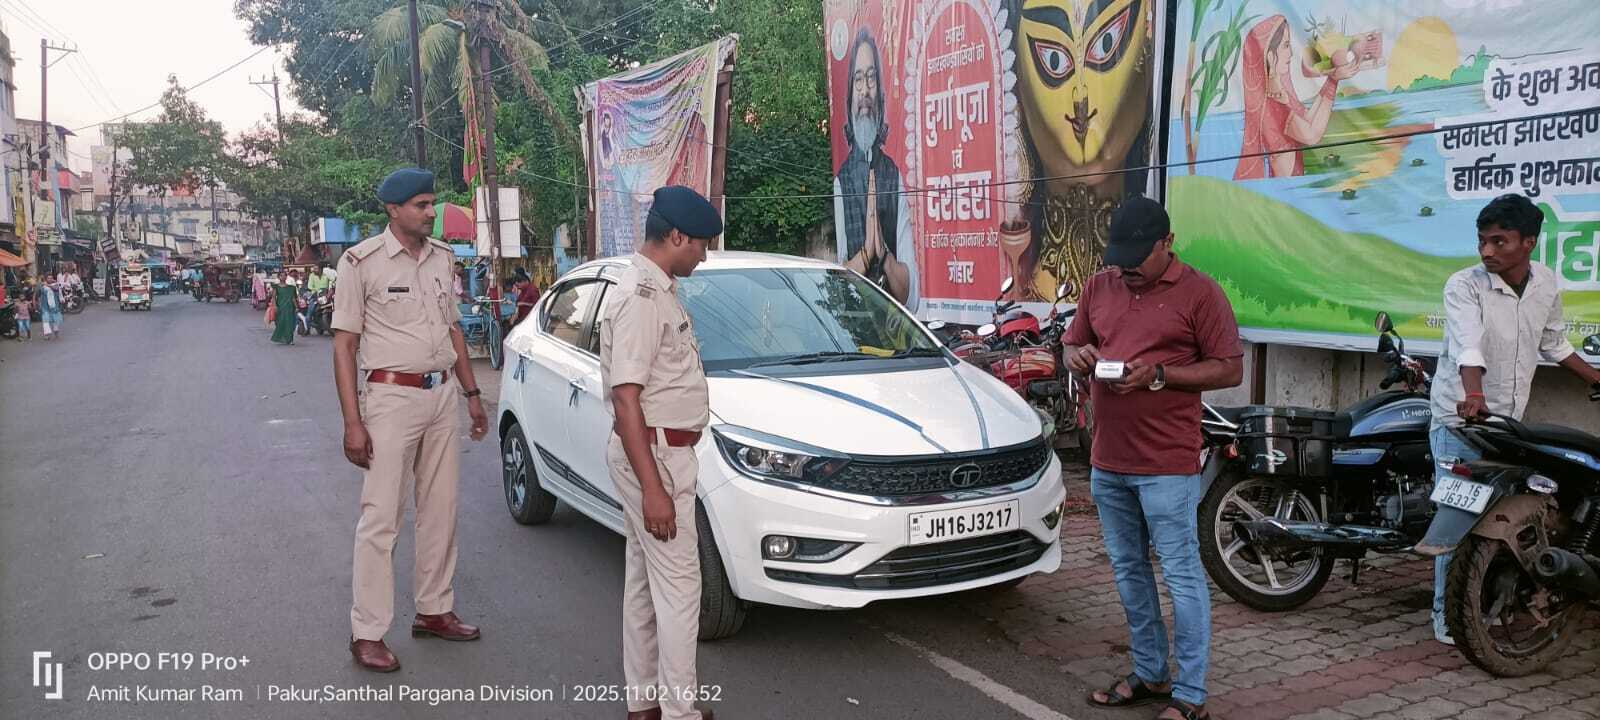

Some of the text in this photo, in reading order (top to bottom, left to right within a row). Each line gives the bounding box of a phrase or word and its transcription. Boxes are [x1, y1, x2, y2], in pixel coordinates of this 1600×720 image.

[1491, 68, 1514, 101] के
[1518, 67, 1563, 106] शुभ
[925, 75, 990, 147] दुर्गा पूजा
[1443, 121, 1508, 150] समस्त
[1452, 153, 1516, 191] हार्दिक
[926, 170, 992, 222] दशहरा
[946, 255, 975, 284] जोहार
[1440, 491, 1476, 509] J6337
[1446, 479, 1480, 497] JH 16
[925, 507, 1012, 538] JH16J3217
